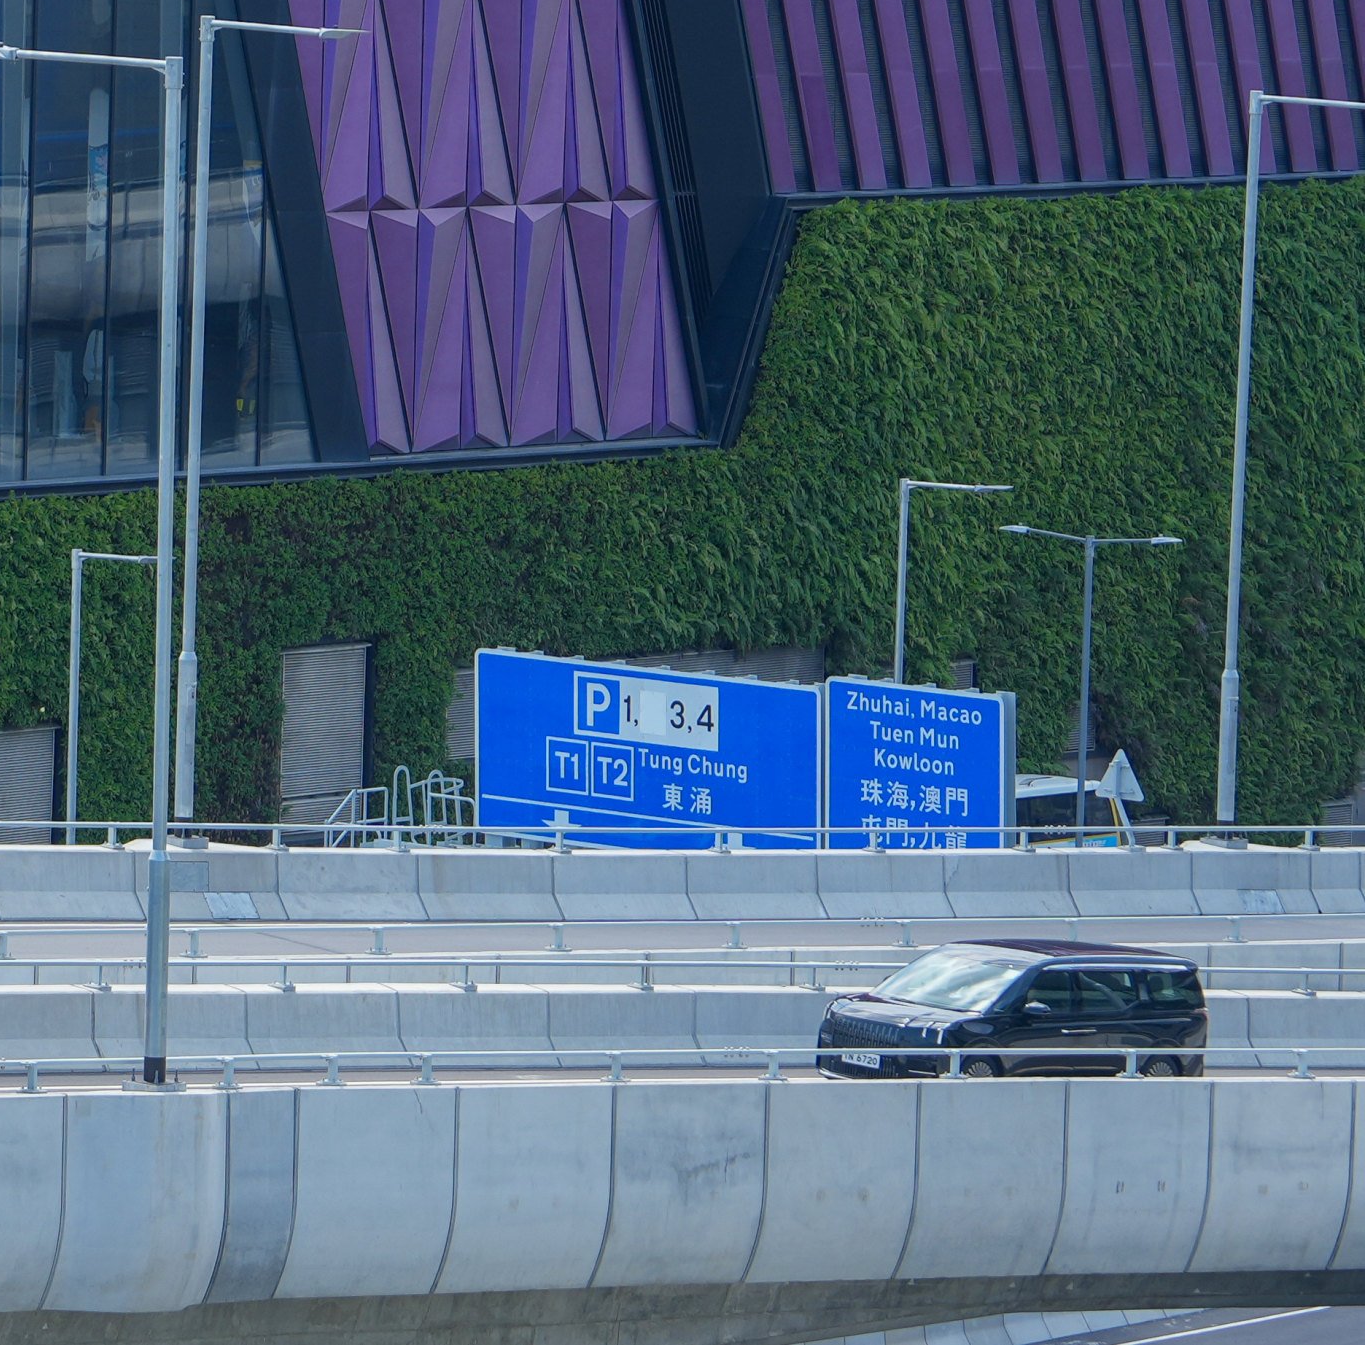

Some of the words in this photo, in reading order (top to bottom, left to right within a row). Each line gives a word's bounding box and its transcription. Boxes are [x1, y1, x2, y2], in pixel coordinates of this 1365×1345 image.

[586, 682, 612, 727] P
[846, 690, 916, 719] Zhuhai,
[920, 699, 983, 726] Macao
[870, 720, 915, 745] Tuen
[919, 726, 960, 750] Mun
[554, 750, 580, 781] T1
[596, 756, 629, 787] T2
[637, 747, 683, 776] Tung
[687, 753, 749, 784] Chung
[873, 747, 956, 776] Kowloon
